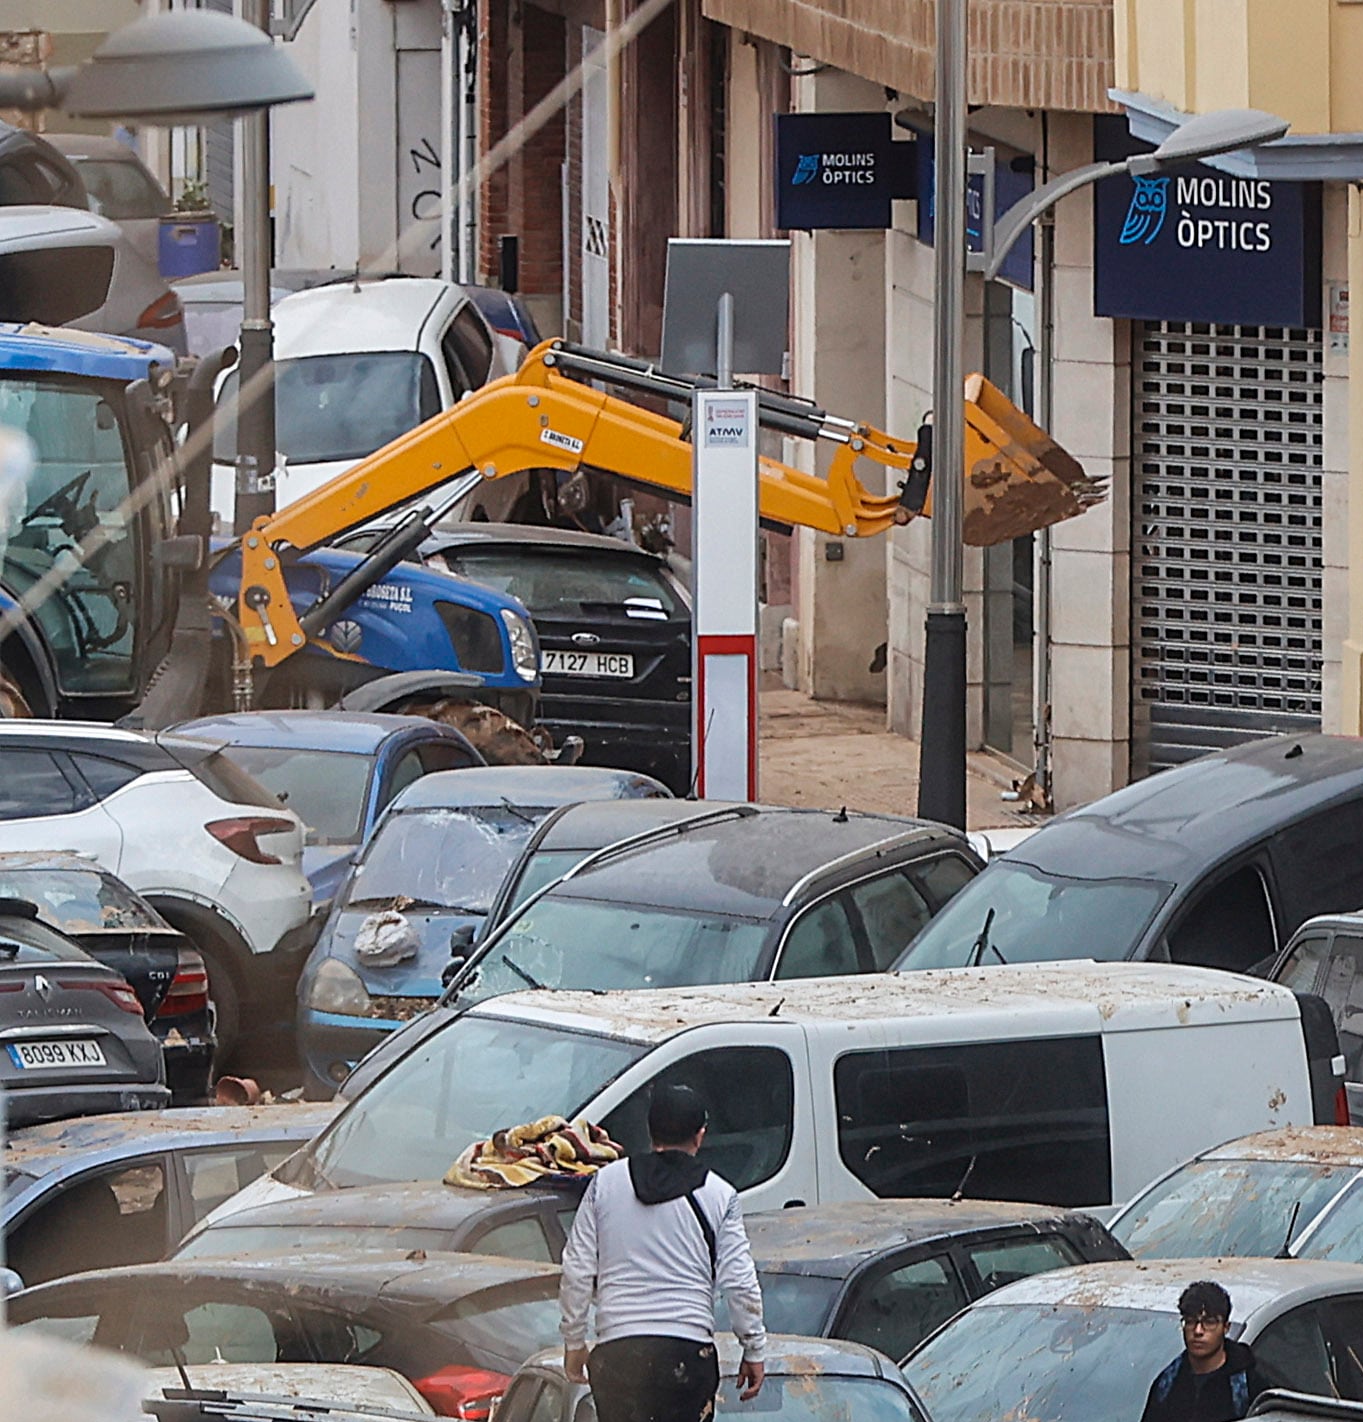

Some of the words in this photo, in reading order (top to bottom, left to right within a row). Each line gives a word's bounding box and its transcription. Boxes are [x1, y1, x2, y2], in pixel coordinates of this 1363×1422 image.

[822, 153, 874, 167] MOLINS
[822, 168, 874, 184] ÒPTICS
[1177, 176, 1271, 209] MOLINS
[1178, 210, 1271, 251] ÒPTICS
[545, 652, 588, 671] 7127
[597, 655, 629, 674] HCB
[20, 1044, 67, 1064] 8099
[64, 1041, 102, 1063] KXJ
